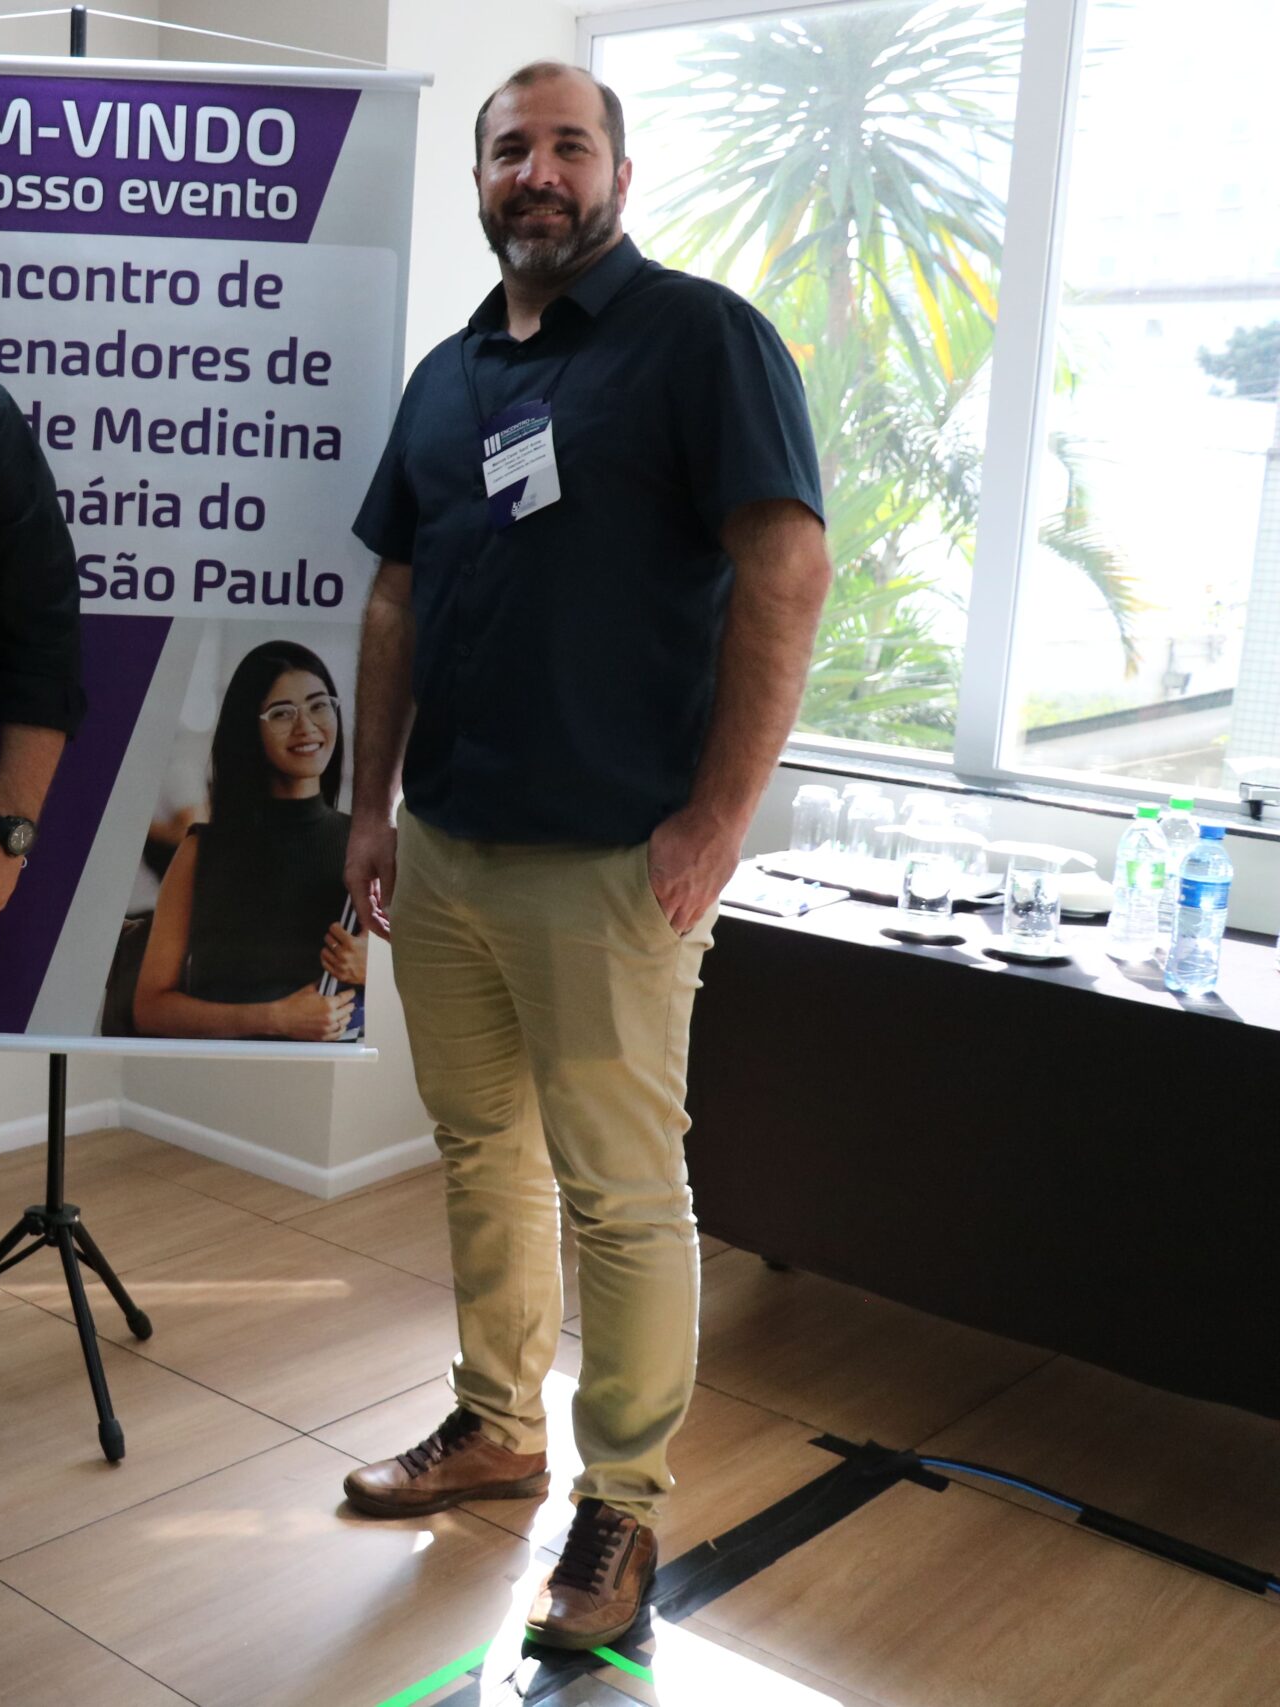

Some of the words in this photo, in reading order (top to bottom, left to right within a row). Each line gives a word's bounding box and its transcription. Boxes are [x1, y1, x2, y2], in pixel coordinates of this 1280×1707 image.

[119, 177, 299, 221] evento
[217, 259, 284, 310] de
[266, 336, 333, 387] de
[92, 407, 343, 461] Medicina
[198, 482, 267, 532] do
[76, 551, 176, 602] São
[193, 558, 345, 608] Paulo
